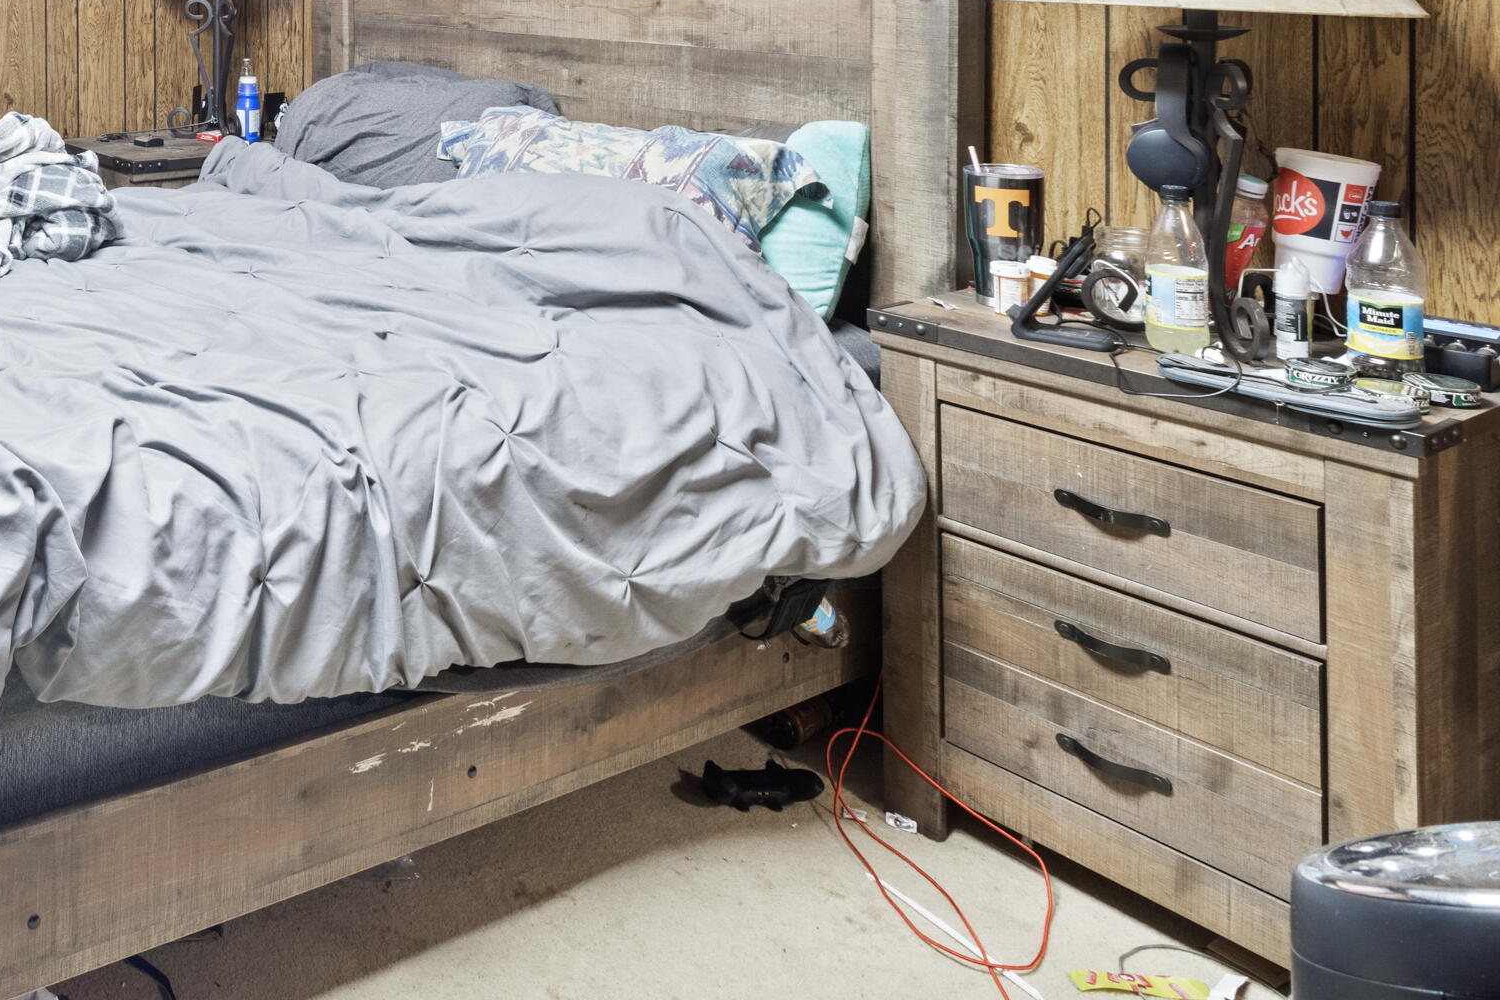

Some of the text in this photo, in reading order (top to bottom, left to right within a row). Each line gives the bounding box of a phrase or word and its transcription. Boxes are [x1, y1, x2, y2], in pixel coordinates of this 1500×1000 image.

[1275, 180, 1318, 217] ack's
[974, 185, 1030, 238] T
[1362, 306, 1400, 319] Minute
[1366, 315, 1395, 326] Maid
